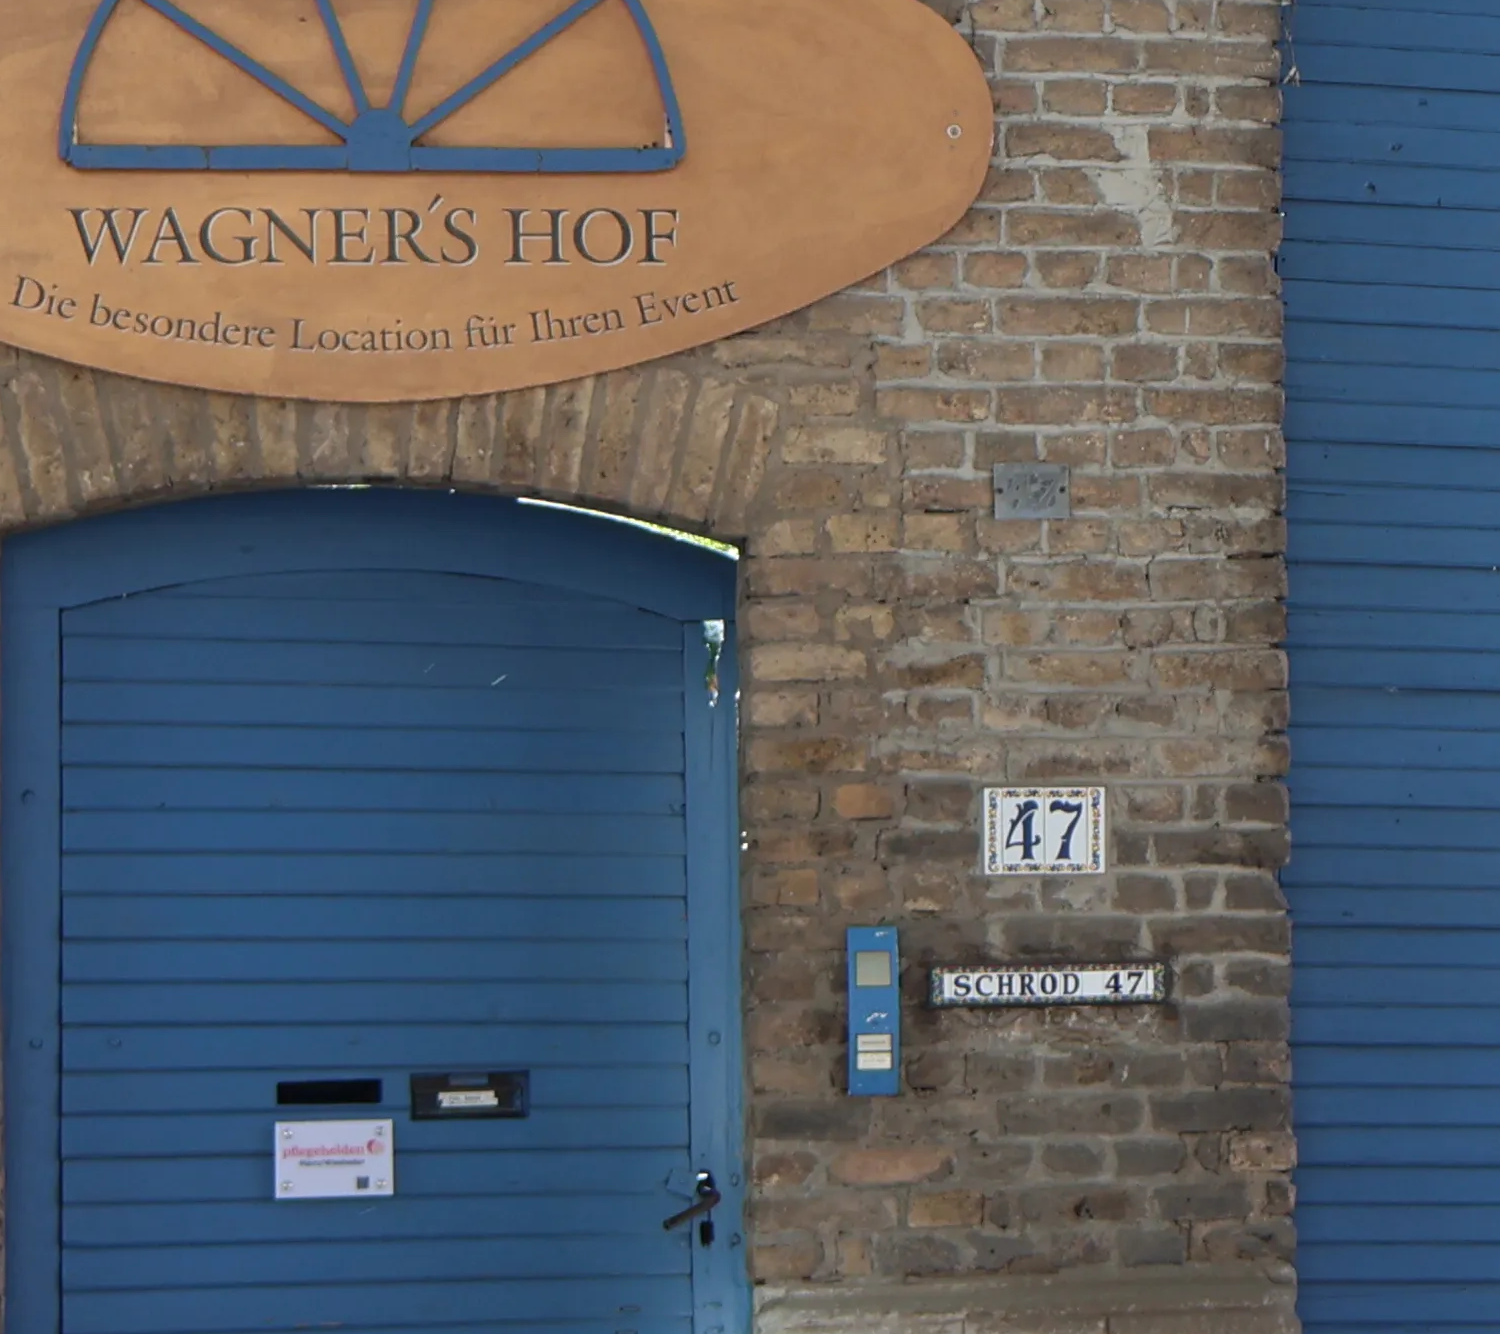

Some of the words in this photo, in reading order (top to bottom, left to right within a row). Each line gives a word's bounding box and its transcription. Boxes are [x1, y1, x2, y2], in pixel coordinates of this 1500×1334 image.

[502, 207, 680, 267] HOF
[8, 274, 77, 320] Die
[89, 293, 276, 349] besondere
[288, 318, 454, 353] Location
[464, 315, 517, 349] für
[528, 307, 625, 344] Ihren
[632, 278, 740, 328] Event
[1004, 799, 1084, 861] 47
[953, 972, 1081, 998] SCHROD
[1104, 971, 1145, 995] 47
